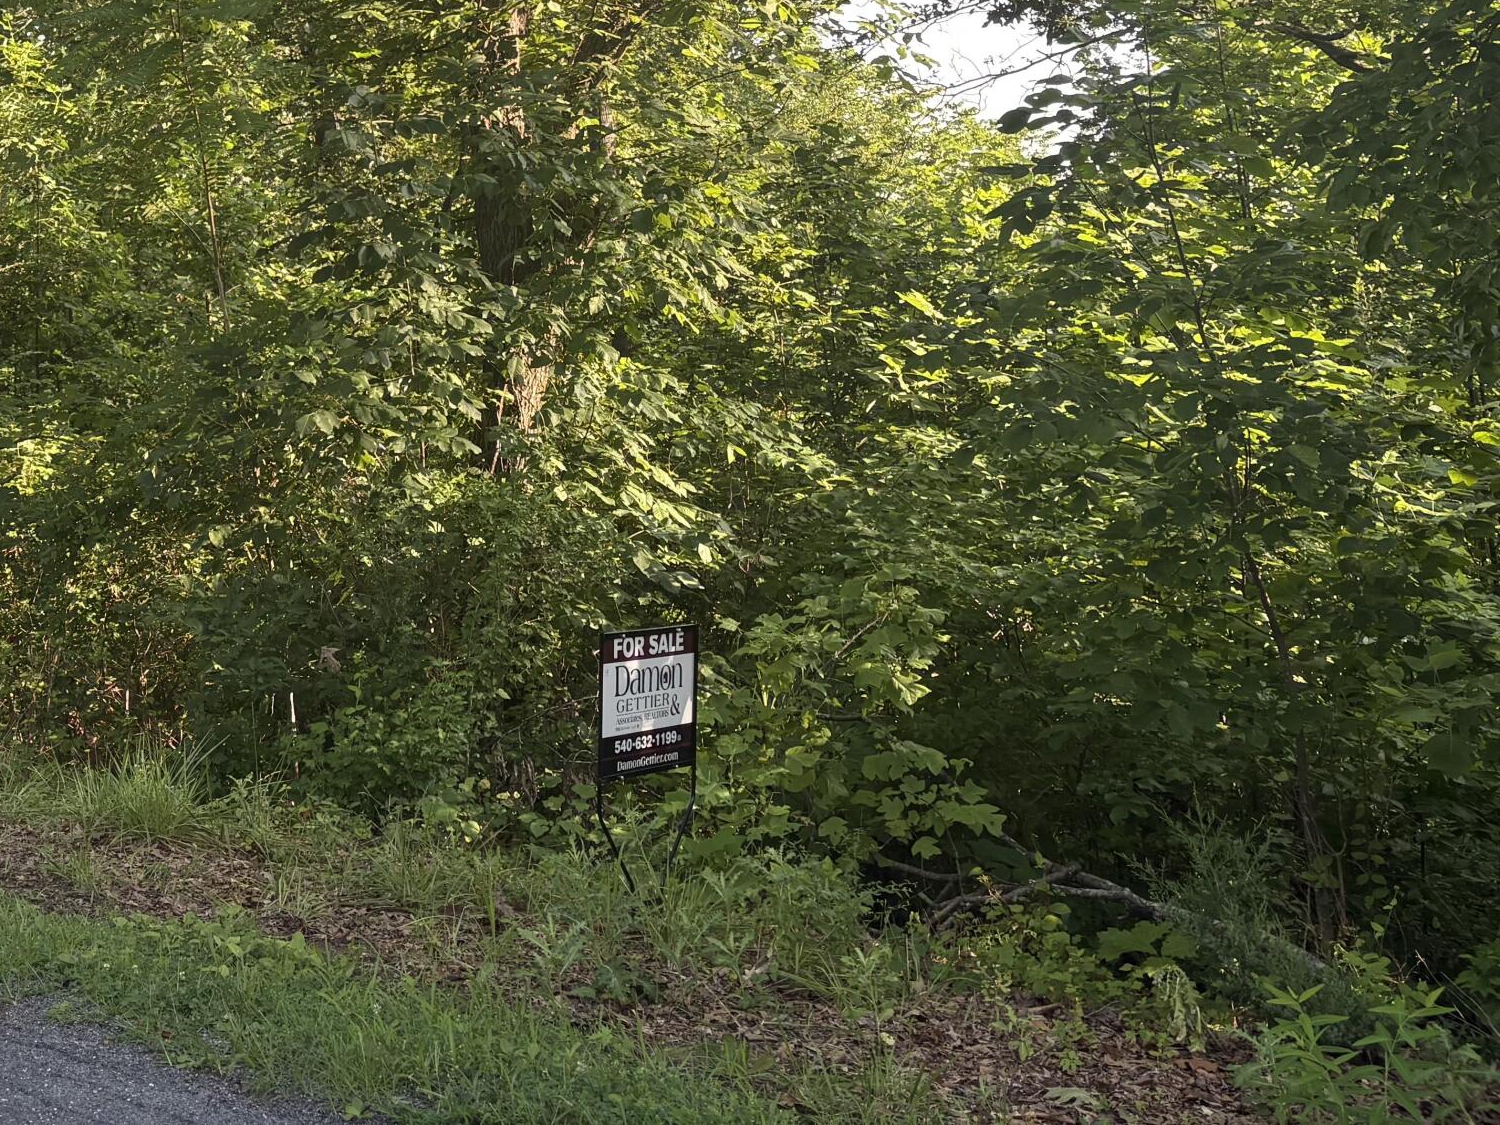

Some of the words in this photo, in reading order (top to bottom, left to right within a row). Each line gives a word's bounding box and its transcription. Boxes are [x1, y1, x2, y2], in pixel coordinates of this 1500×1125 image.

[614, 637, 644, 659] FOR
[649, 632, 684, 655] SALE
[614, 663, 682, 697] Damon
[616, 693, 670, 713] GETTIER
[670, 693, 680, 716] &
[617, 751, 678, 771] DamonGettier.com
